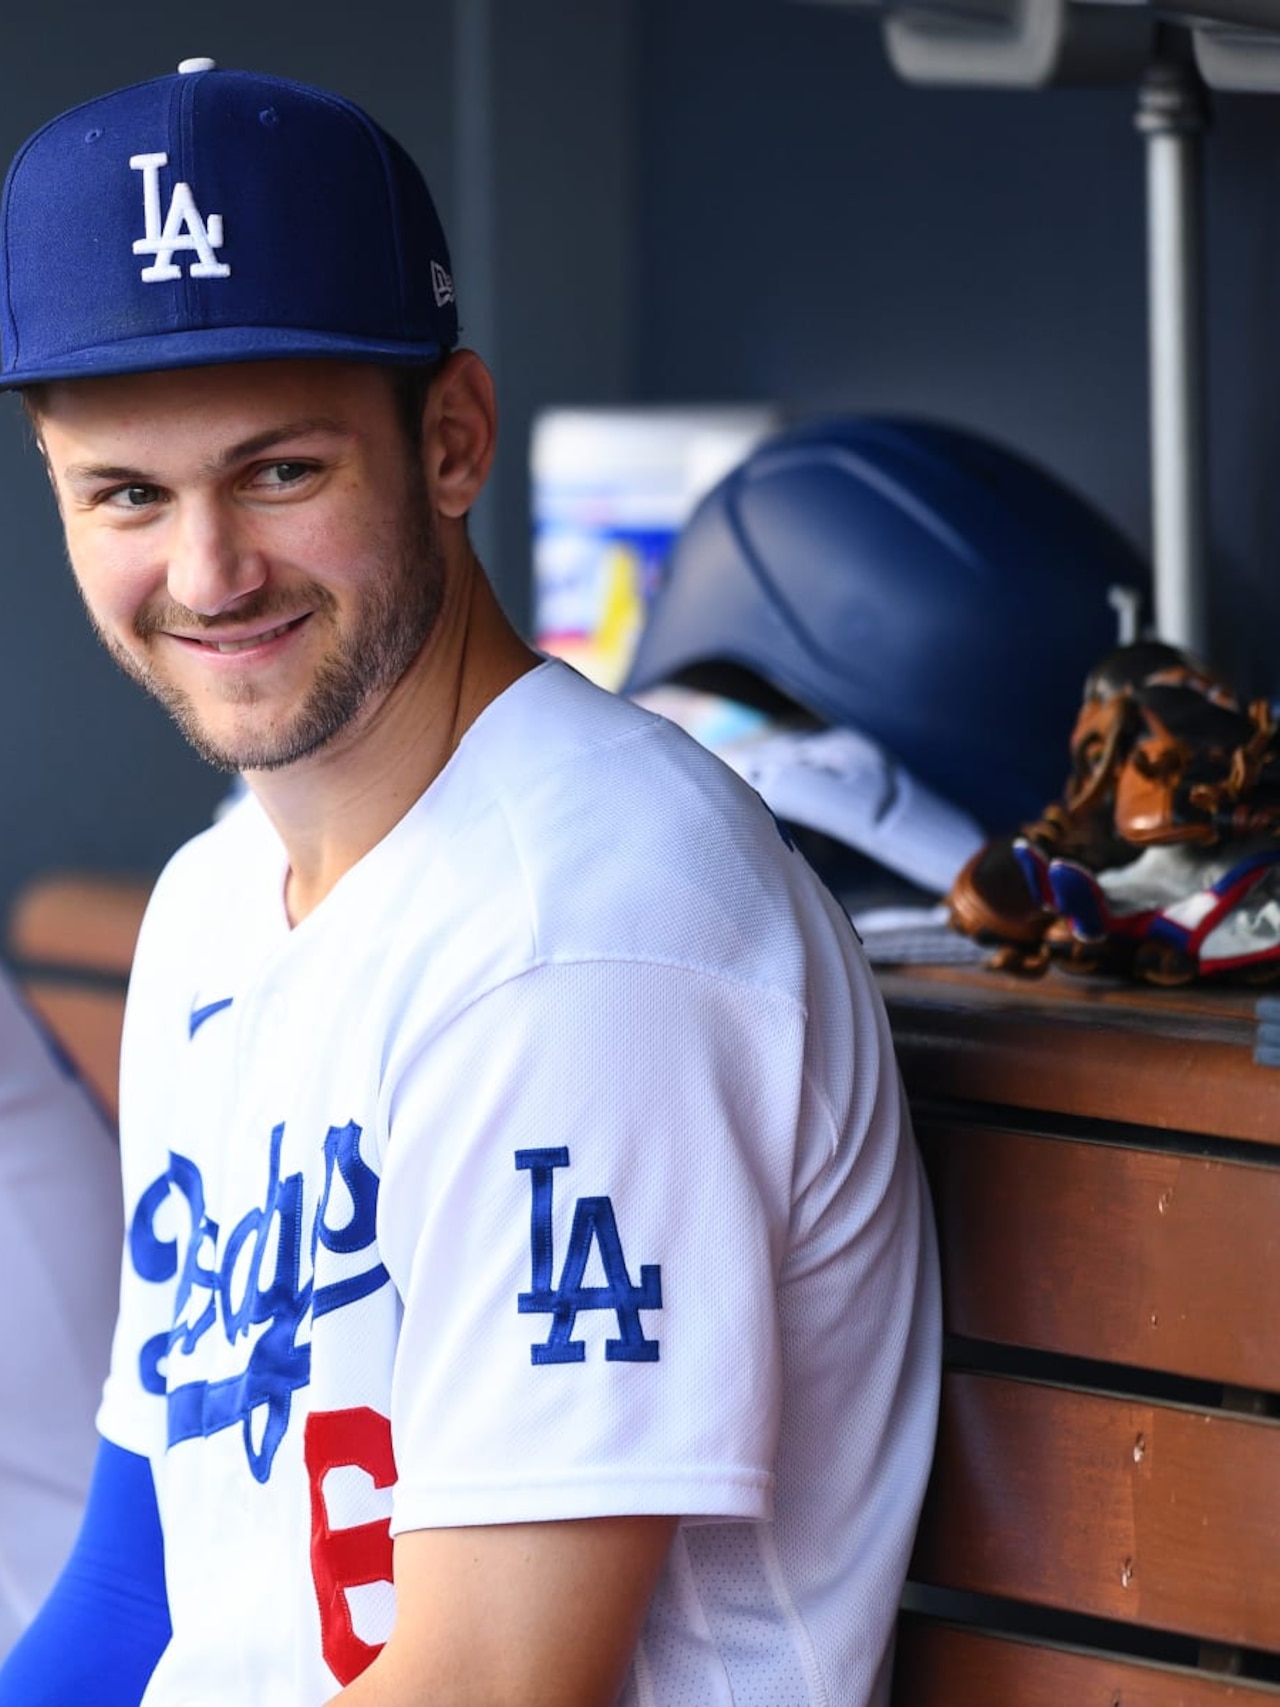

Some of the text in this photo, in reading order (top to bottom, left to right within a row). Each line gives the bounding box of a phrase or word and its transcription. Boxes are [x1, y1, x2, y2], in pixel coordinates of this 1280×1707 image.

[129, 152, 231, 283] LA
[515, 1146, 664, 1365] LA
[304, 1407, 398, 1690] 6
